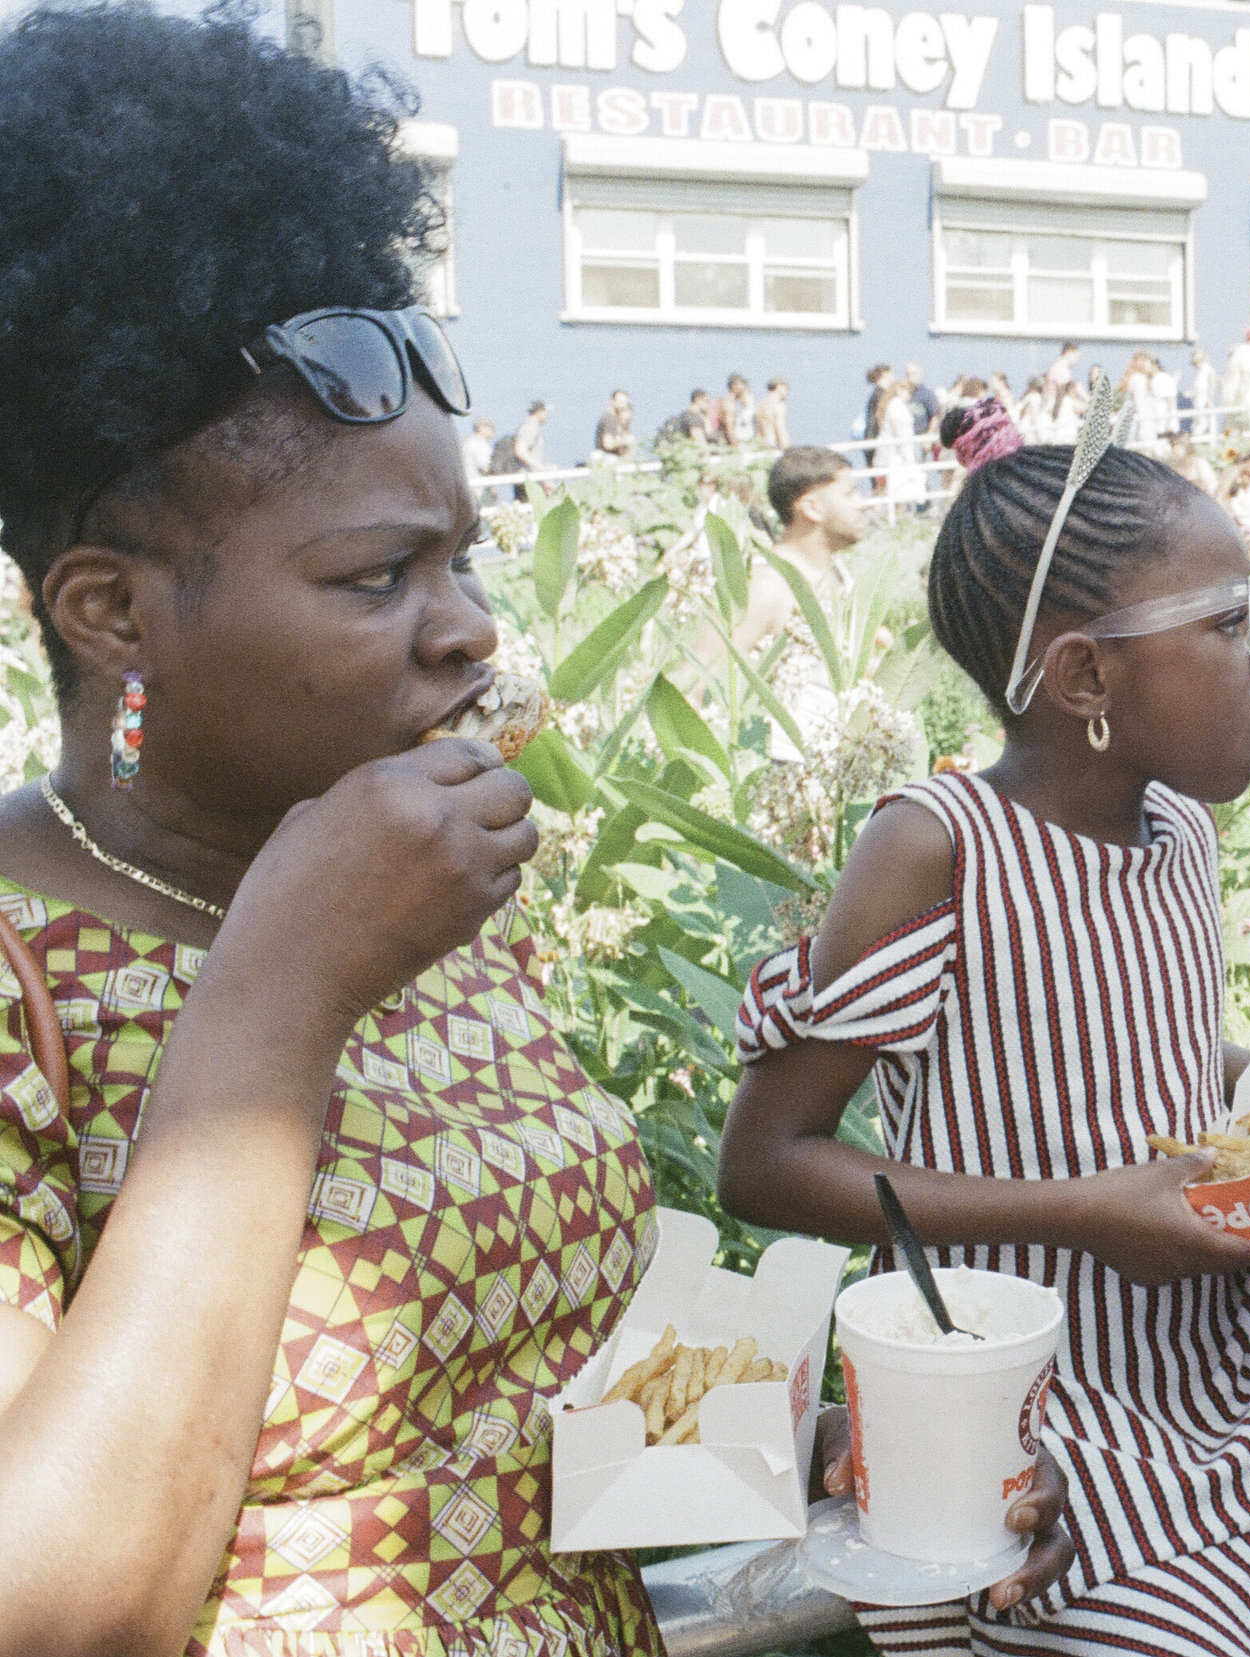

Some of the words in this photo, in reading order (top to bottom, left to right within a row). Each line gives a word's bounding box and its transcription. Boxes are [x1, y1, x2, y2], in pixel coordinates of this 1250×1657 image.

[408, 0, 688, 72] Tom's
[717, 0, 999, 110] Coney
[491, 79, 1003, 156] RESTAURANT
[1048, 118, 1184, 169] BAR
